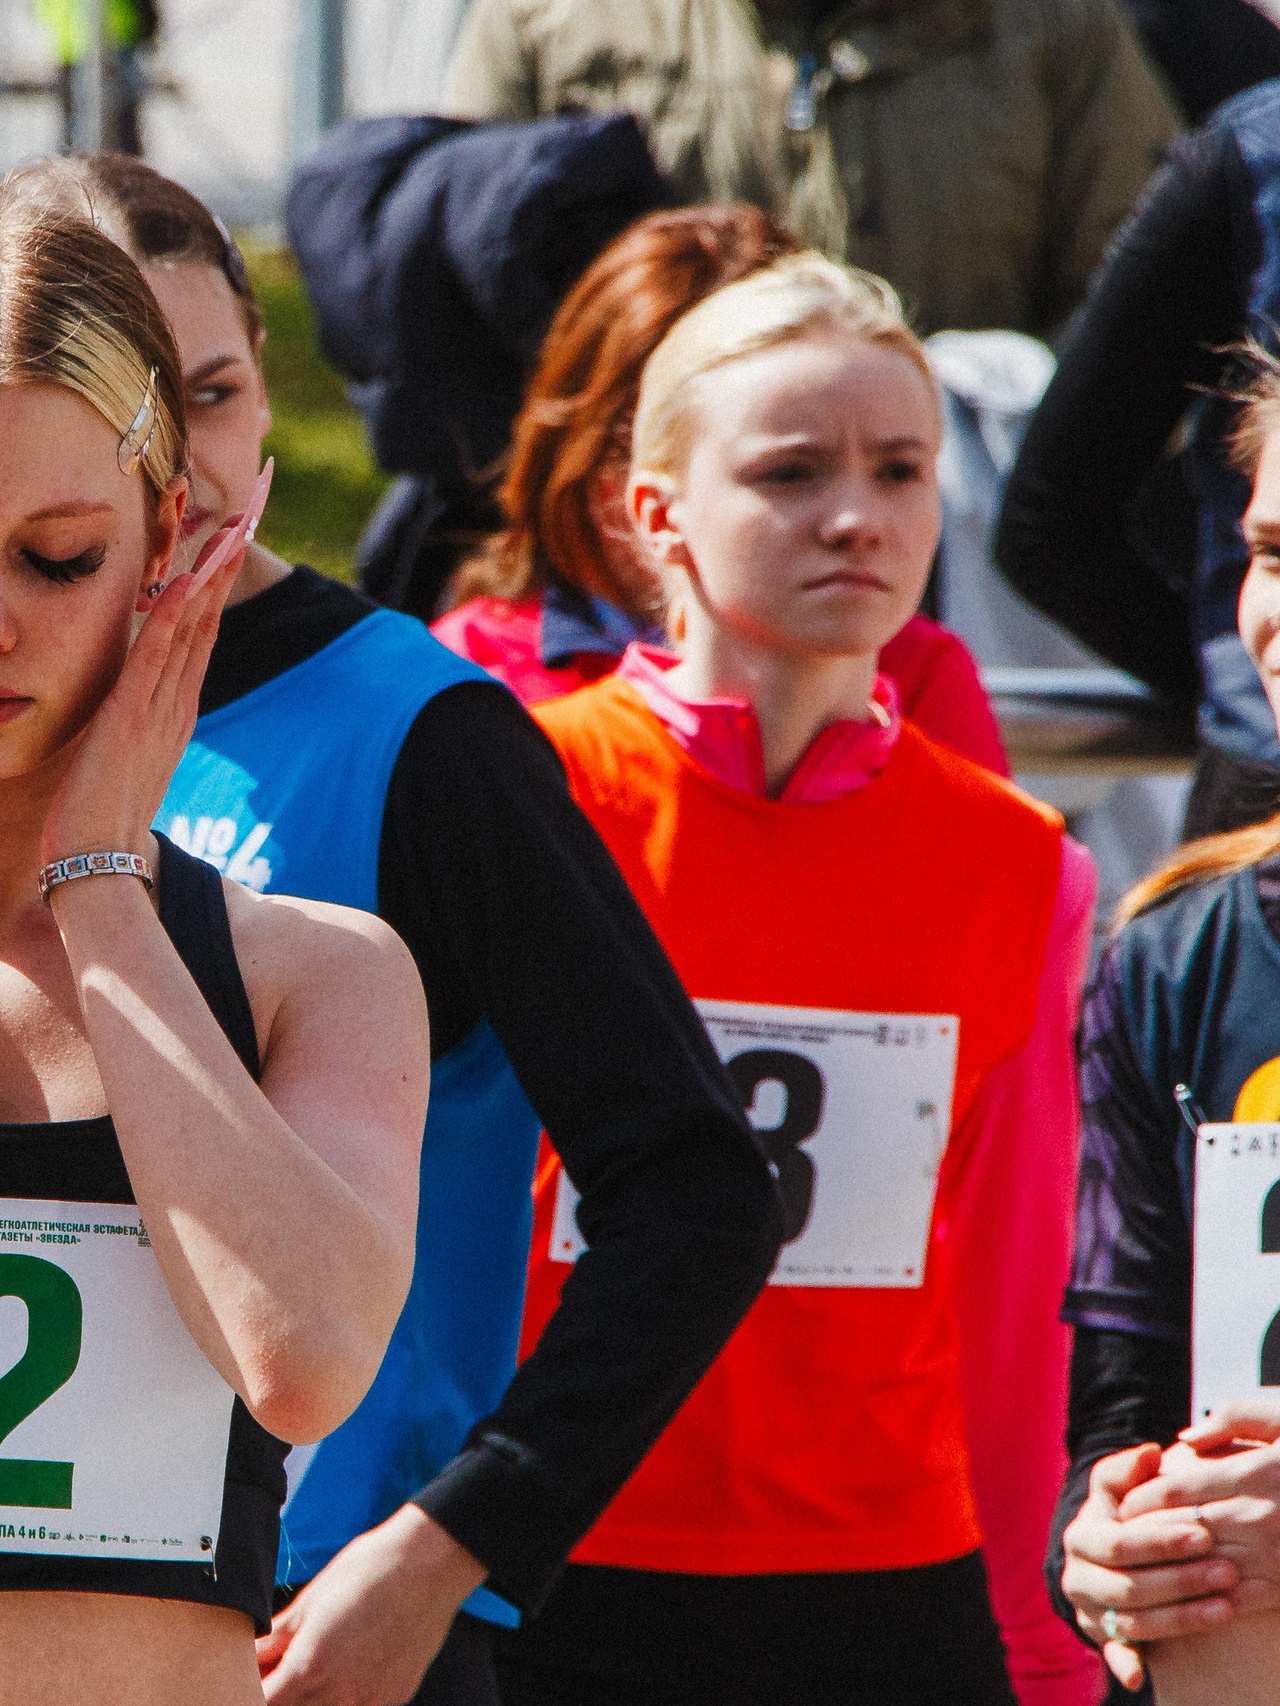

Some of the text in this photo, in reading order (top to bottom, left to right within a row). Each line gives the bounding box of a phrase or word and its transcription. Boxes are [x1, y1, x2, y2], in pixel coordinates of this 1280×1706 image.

[93, 1224, 138, 1236] ЭСТАФЕТА
[35, 1233, 81, 1246] «ЗВЕЗДА»
[18, 1526, 26, 1539] 4
[28, 1529, 36, 1539] и
[38, 1527, 46, 1540] 6
